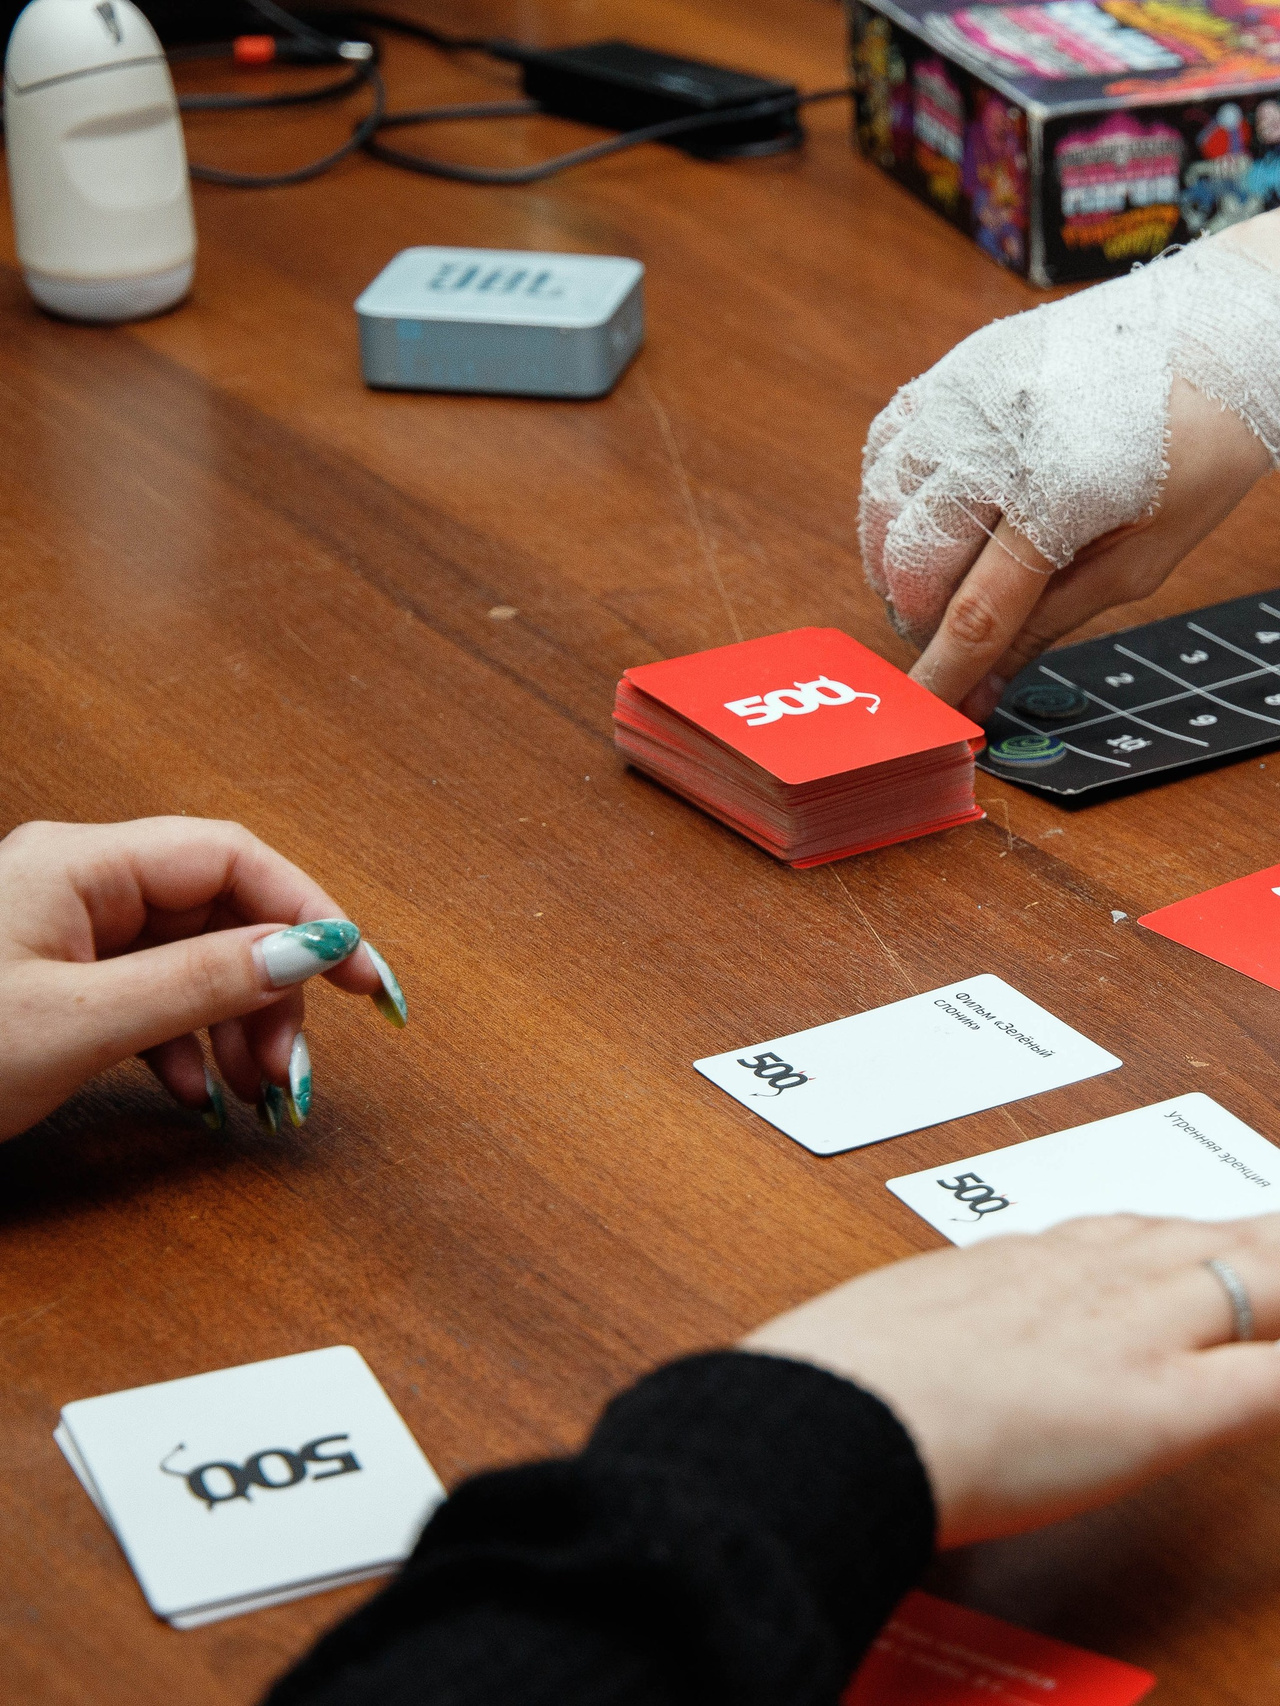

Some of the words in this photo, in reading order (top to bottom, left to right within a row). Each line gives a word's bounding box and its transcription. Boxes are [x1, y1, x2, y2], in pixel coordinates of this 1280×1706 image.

[1180, 650, 1209, 664] 3
[1105, 672, 1135, 687] 2
[723, 676, 870, 727] 500
[1189, 714, 1218, 727] 9
[1106, 734, 1150, 753] 10
[933, 999, 981, 1030] слоник»
[955, 992, 996, 1021] Фильм
[994, 1020, 1055, 1058] «Зелёный
[737, 1052, 814, 1094] 500
[1164, 1110, 1222, 1153] Утренняя
[1218, 1152, 1271, 1188] эрекция
[936, 1172, 1015, 1219] 500
[172, 1432, 363, 1510] 500
